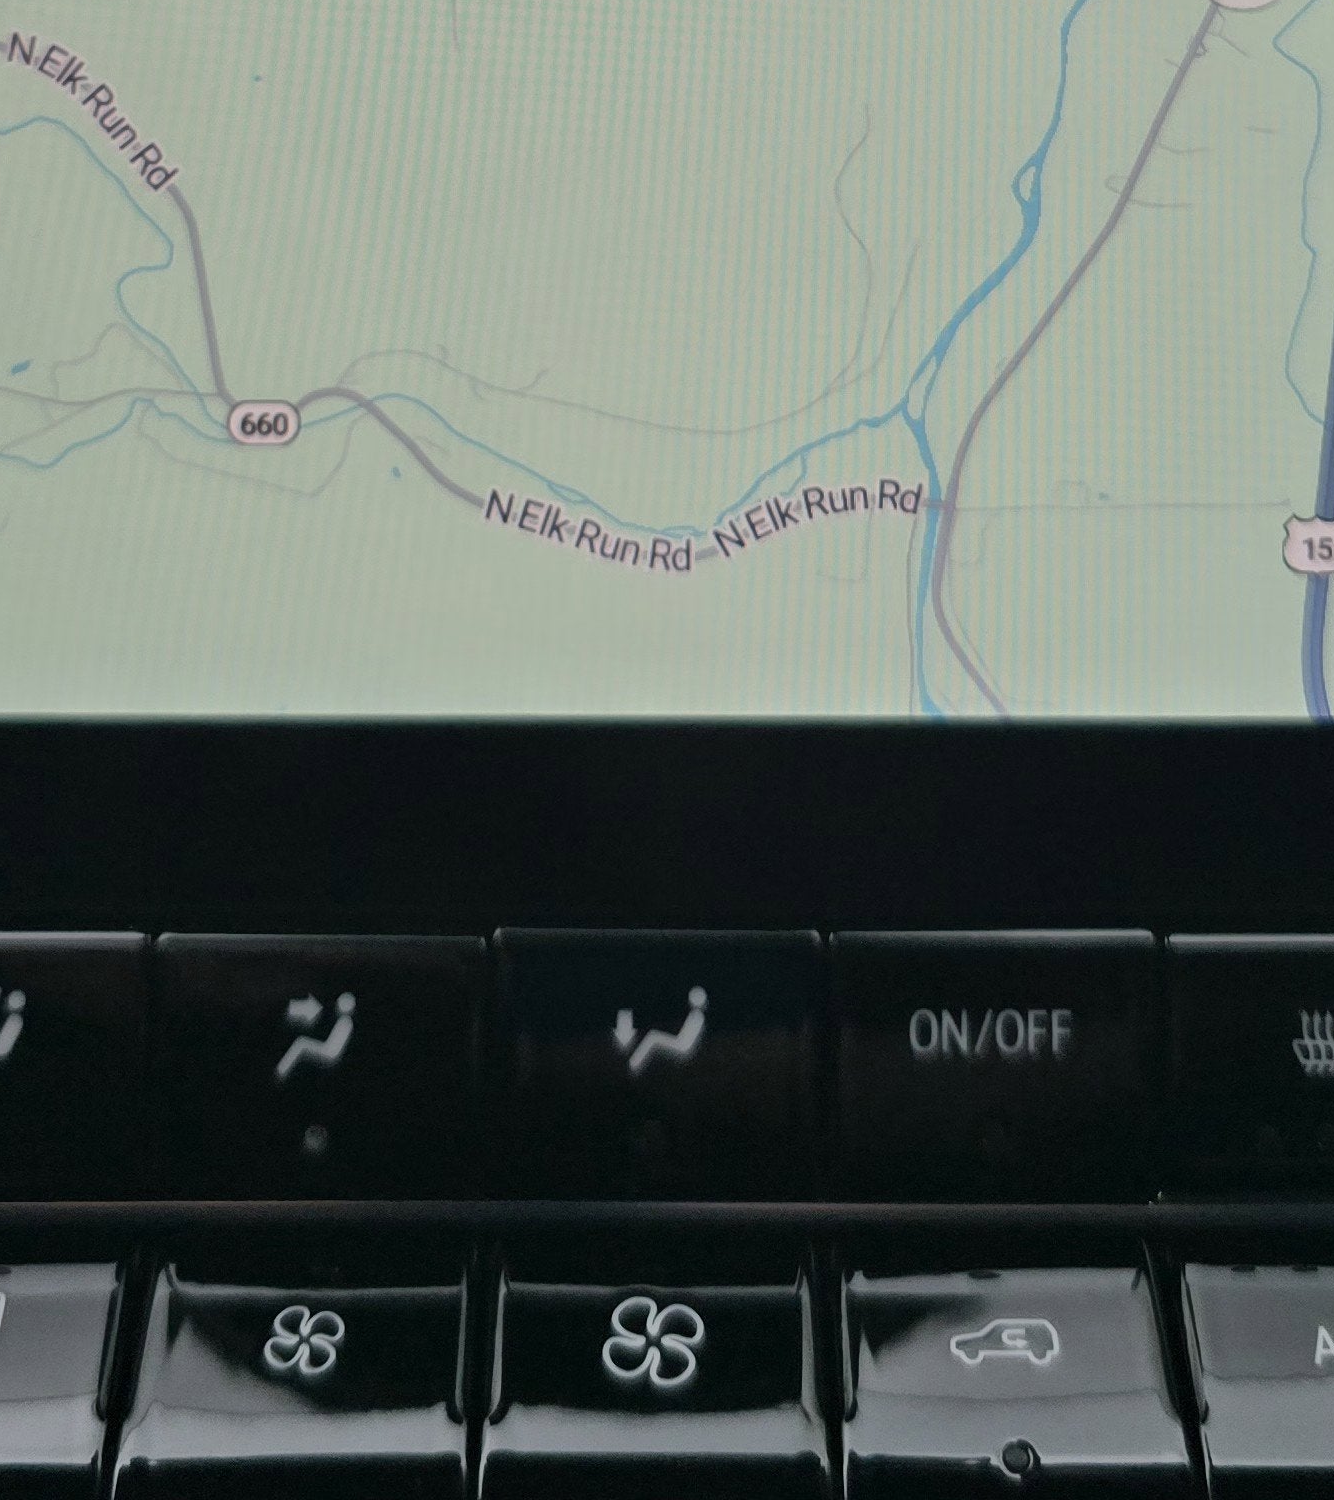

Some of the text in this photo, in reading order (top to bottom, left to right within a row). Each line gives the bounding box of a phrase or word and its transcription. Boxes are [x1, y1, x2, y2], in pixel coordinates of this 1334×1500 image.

[7, 31, 179, 190] N Elk Run Rd
[239, 410, 290, 438] 660
[484, 489, 692, 571] N Elk Run Rd
[712, 478, 924, 557] N Elk Run Rd
[1302, 536, 1334, 562] 15
[909, 1008, 1073, 1057] ON/OFF
